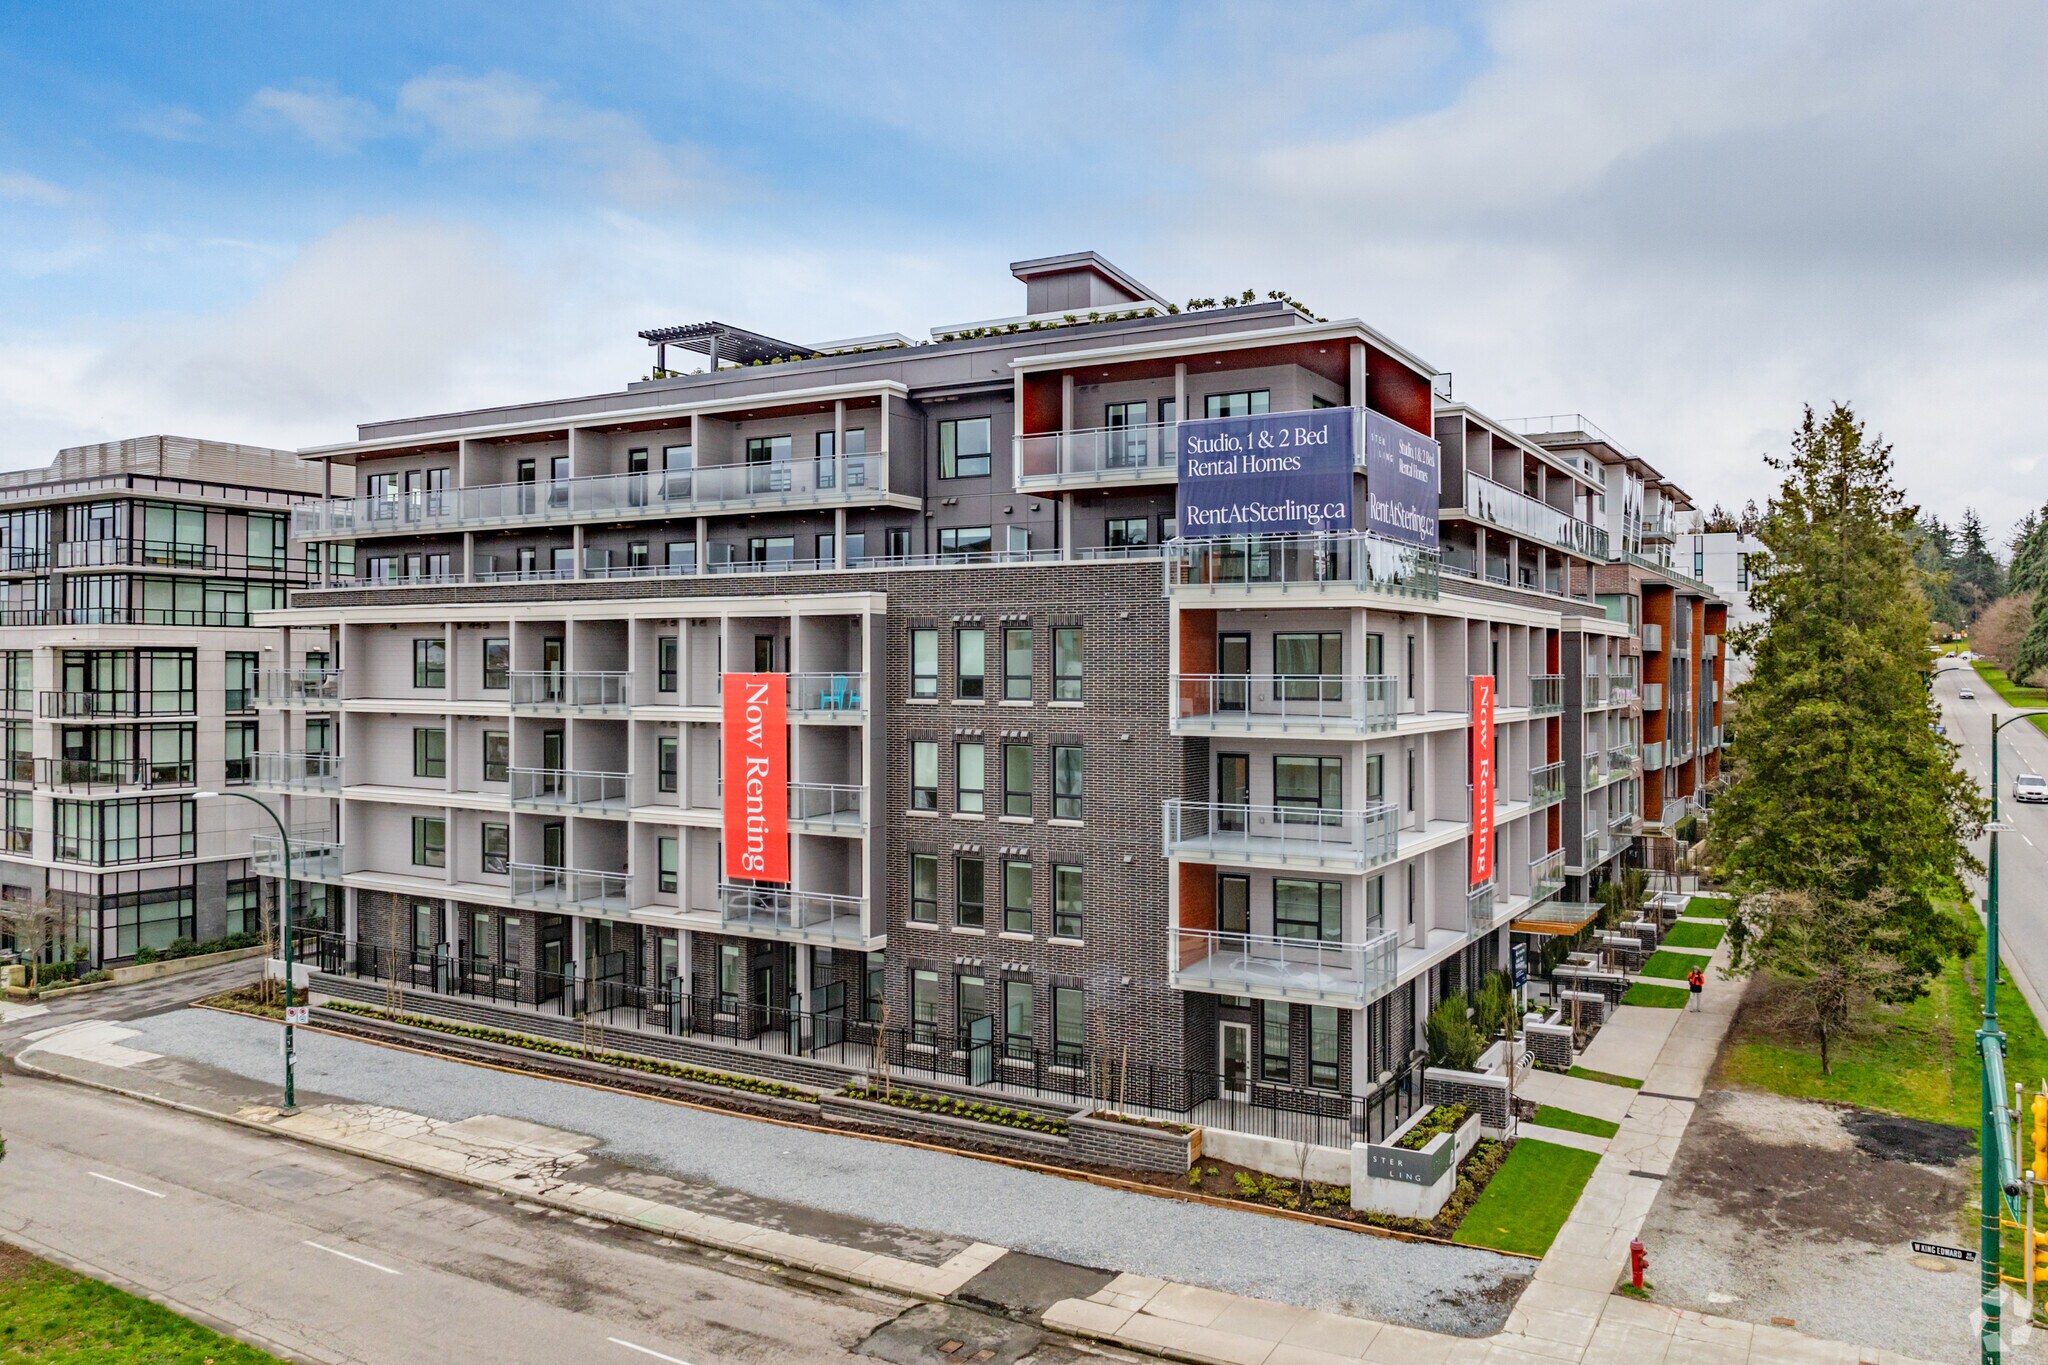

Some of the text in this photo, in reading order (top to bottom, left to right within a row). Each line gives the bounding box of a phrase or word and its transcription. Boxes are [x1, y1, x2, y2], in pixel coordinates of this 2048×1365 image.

[1187, 425, 1328, 455] Studio, 1 & 2 Bed
[1187, 453, 1301, 478] Rental Homes
[1398, 457, 1428, 483] Rental Homes
[1426, 450, 1435, 468] Bed
[1186, 499, 1346, 526] RentAtSterling.ca
[1370, 492, 1435, 540] RentAtSterling.ca
[741, 682, 769, 873] Now Renting
[1476, 685, 1489, 874] Now Renting
[1372, 1155, 1403, 1167] STER
[1389, 1170, 1421, 1182] LING
[1914, 1243, 1963, 1258] W KING EDWARD
